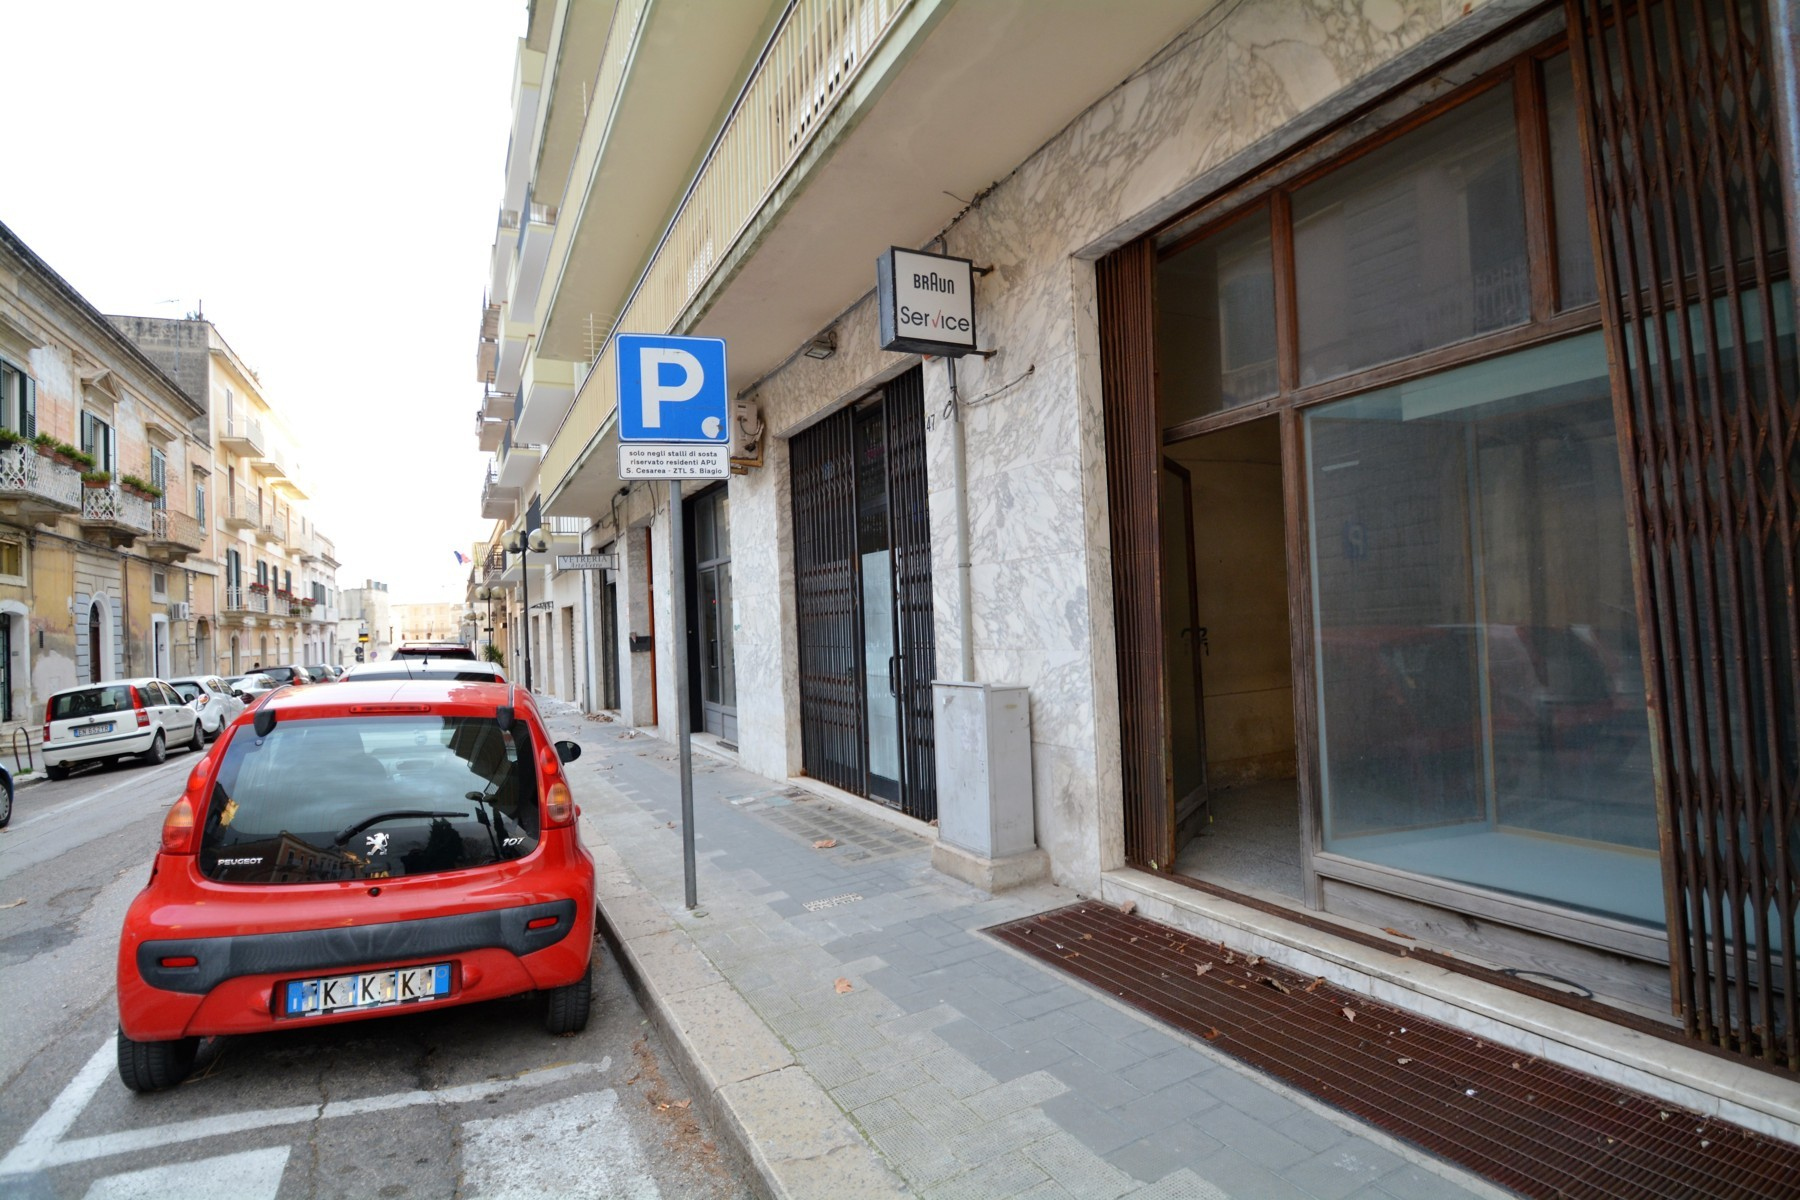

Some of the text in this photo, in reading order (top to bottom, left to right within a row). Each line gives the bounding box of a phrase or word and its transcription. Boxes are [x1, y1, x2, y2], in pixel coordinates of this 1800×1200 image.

[913, 272, 955, 295] BRAUN
[900, 305, 970, 332] Service
[639, 347, 705, 429] P
[926, 413, 936, 432] 47
[647, 450, 666, 458] negli
[502, 836, 526, 847] 107
[217, 857, 264, 866] PEUGEOT
